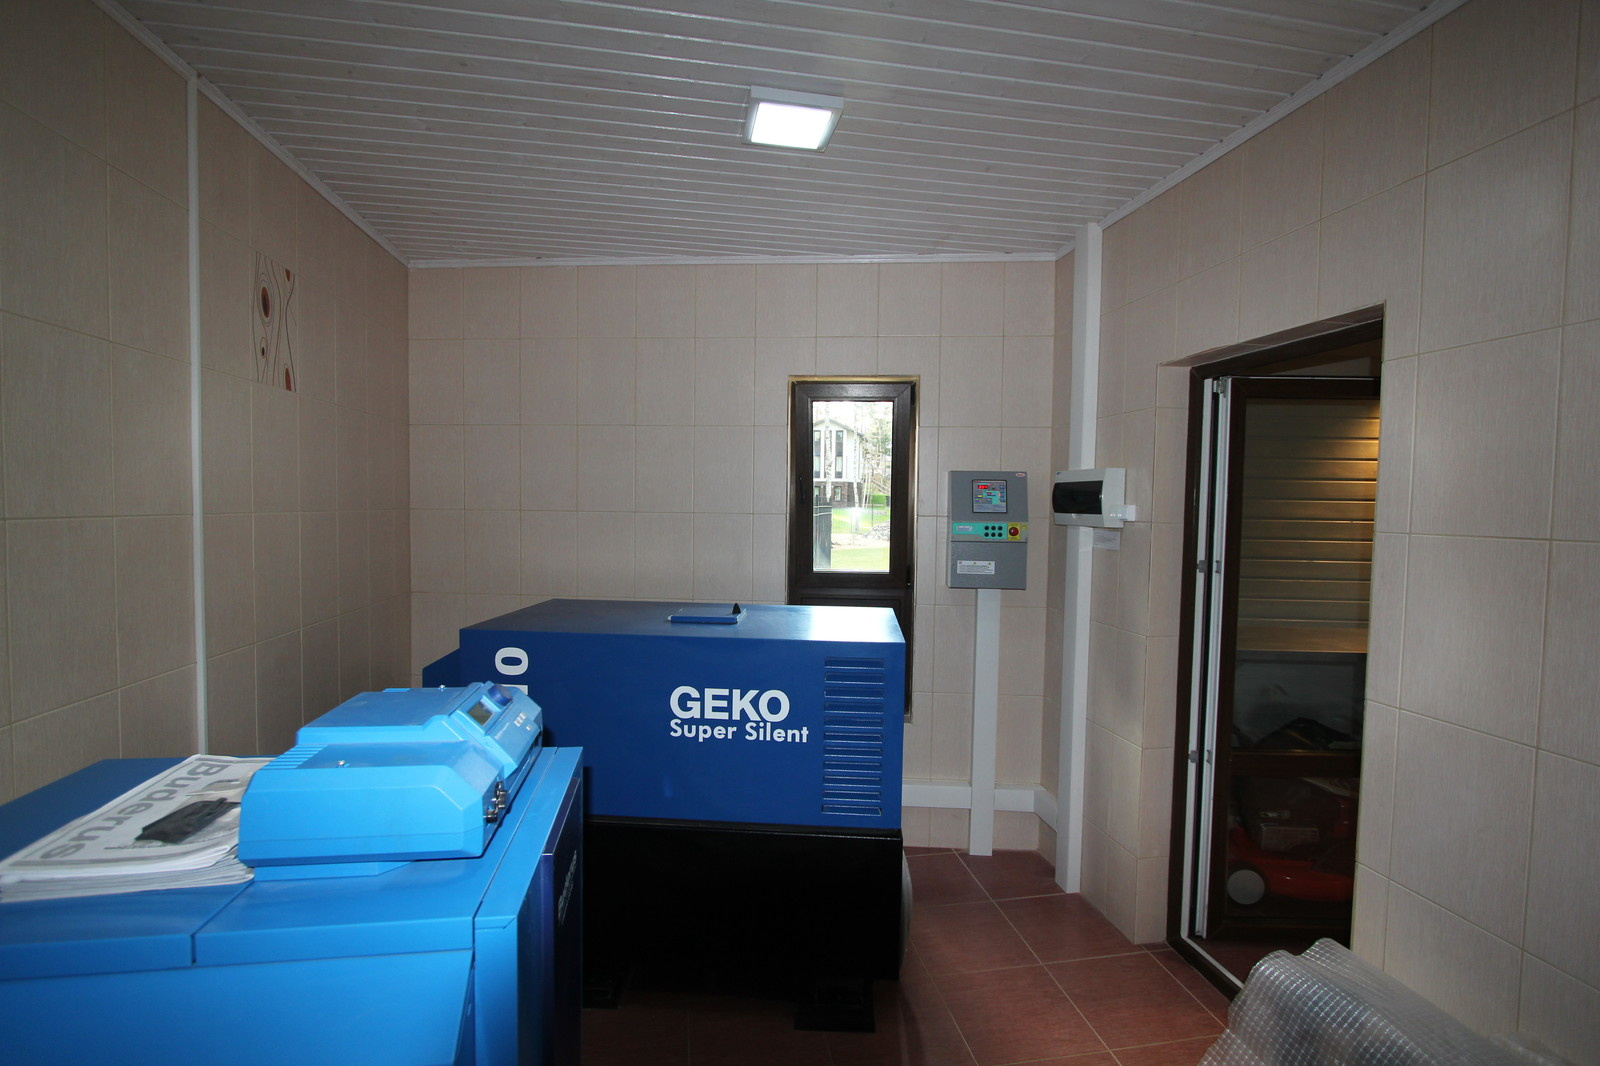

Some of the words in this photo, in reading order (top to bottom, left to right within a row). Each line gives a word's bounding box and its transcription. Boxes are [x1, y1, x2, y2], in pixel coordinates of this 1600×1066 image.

[670, 686, 790, 722] GEKO
[670, 719, 737, 742] Super
[745, 722, 809, 743] Silent
[40, 762, 231, 859] Buderus
